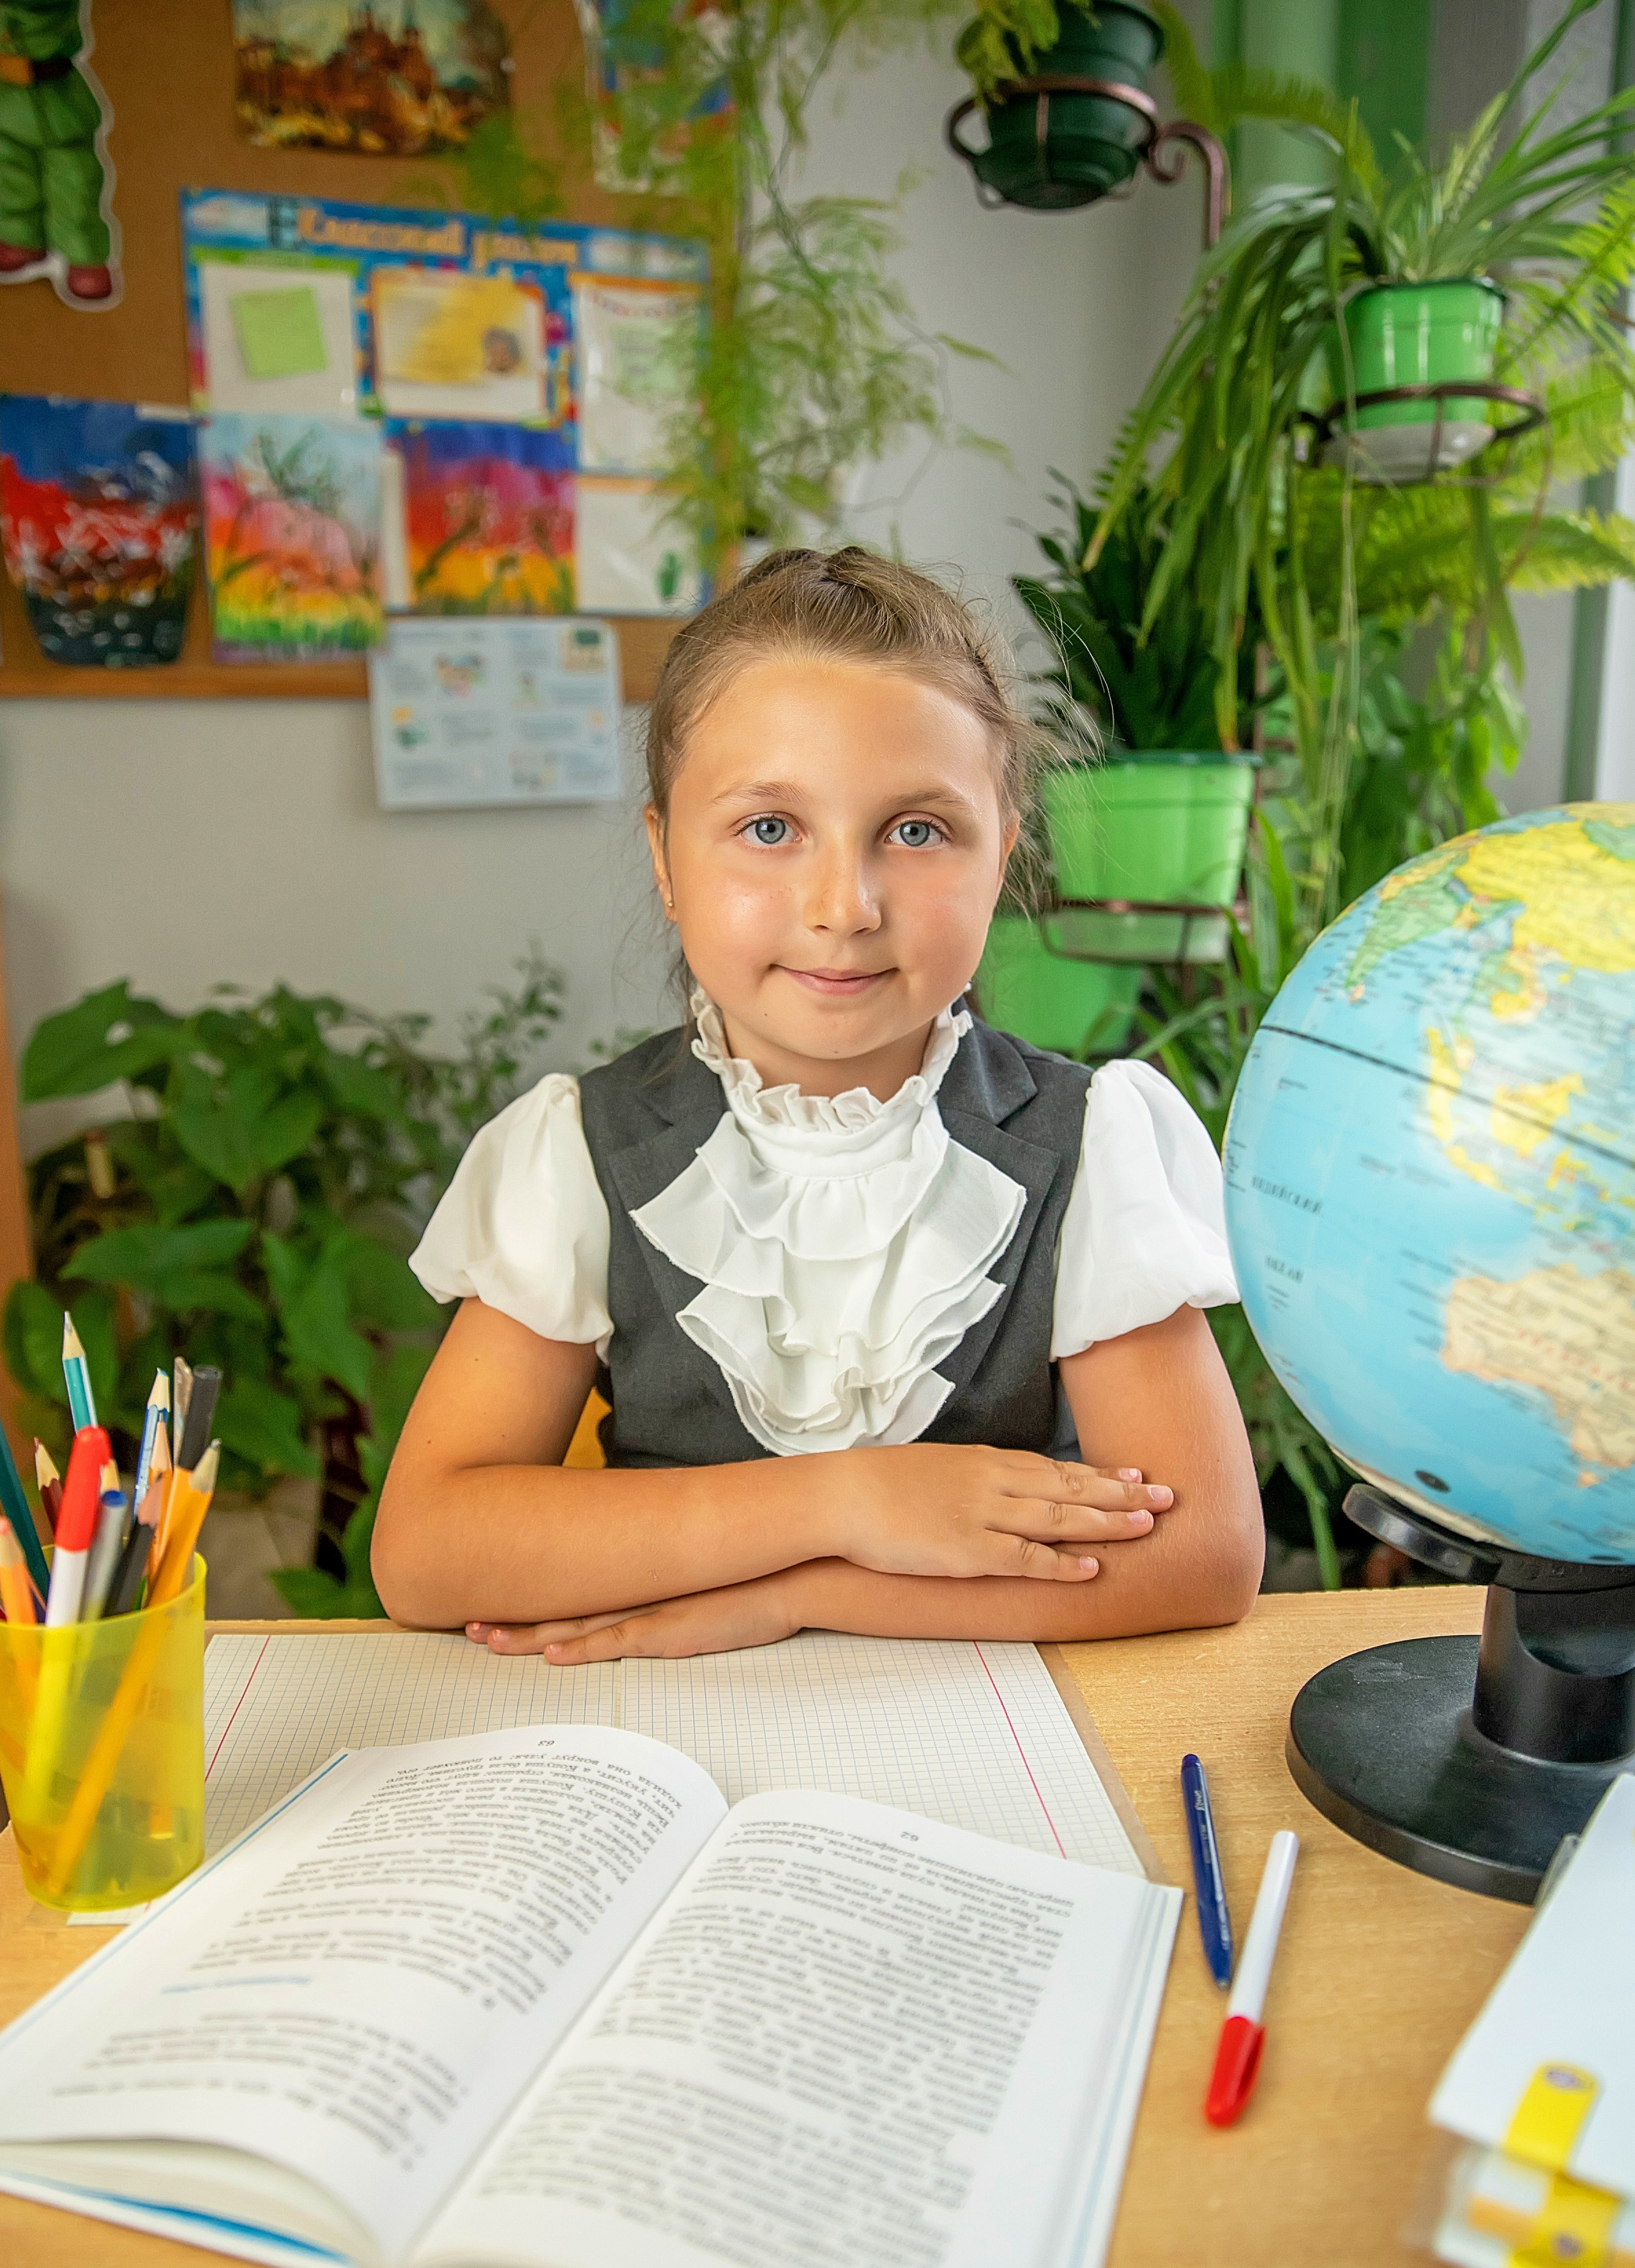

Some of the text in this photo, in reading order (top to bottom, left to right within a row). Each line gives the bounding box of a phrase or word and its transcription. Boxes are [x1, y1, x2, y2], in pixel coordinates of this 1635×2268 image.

[422, 1757, 483, 1771] понюхает
[524, 1761, 578, 1772] Копуша
[551, 1754, 599, 1765] вокруг
[443, 1771, 480, 1780] вдруг
[607, 1763, 630, 1776] она
[386, 1772, 423, 1783] Долго
[519, 1777, 574, 1791] Копуша
[596, 1769, 647, 1796] укусит,
[512, 1786, 584, 1802] положили
[637, 1775, 681, 1809] ходила
[582, 1787, 642, 1820] Копушу.
[651, 1793, 674, 1819] чит,
[567, 1804, 598, 1821] Для
[590, 1799, 637, 1829] землю,
[636, 1798, 669, 1829] Вещь
[646, 1820, 662, 1835] ли
[791, 1822, 843, 1836] отняли
[640, 1829, 655, 1845] на
[900, 1831, 918, 1841] 62
